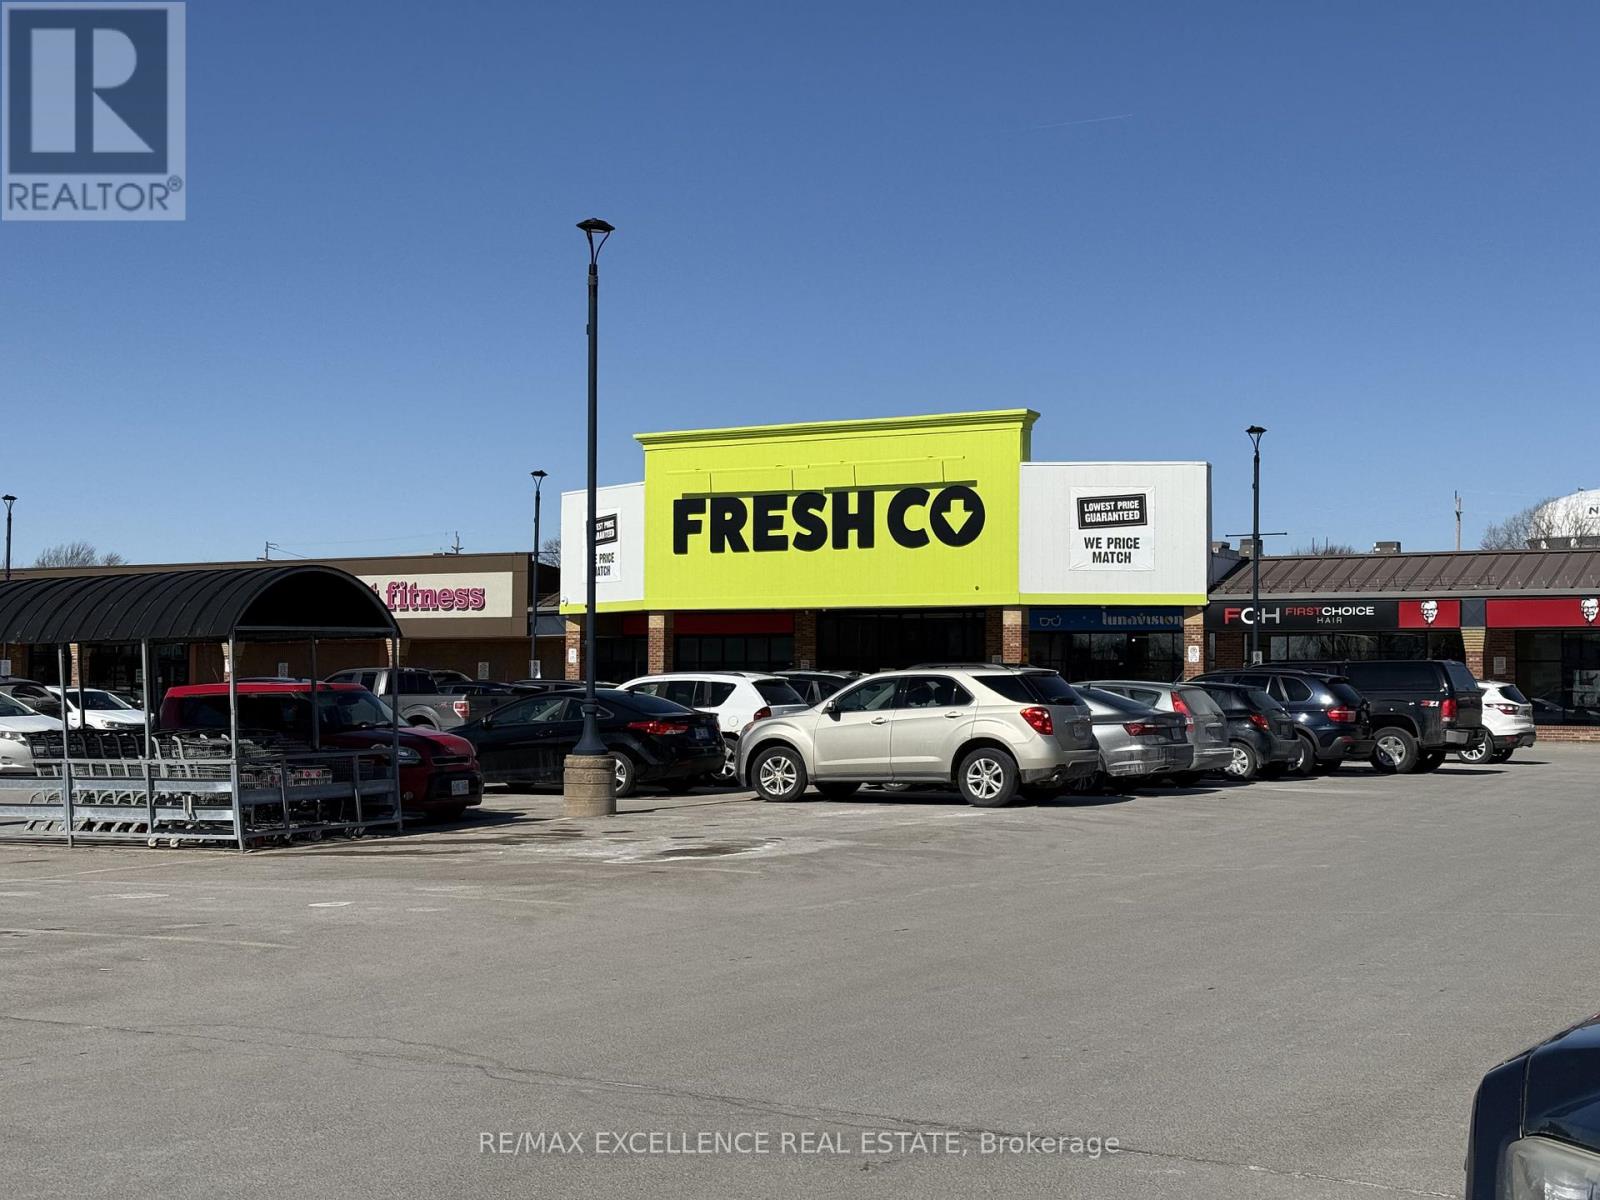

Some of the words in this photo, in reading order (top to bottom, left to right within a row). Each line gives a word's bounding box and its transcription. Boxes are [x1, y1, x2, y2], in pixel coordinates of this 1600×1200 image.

[1084, 502, 1115, 512] LOWEST
[1117, 500, 1140, 510] PRICE
[673, 490, 875, 555] FRESH
[1084, 511, 1140, 523] GUARANTEED
[1084, 537, 1102, 549] WE
[1107, 537, 1140, 549] PRICE
[599, 552, 615, 564] PRICE
[1092, 551, 1132, 564] MATCH
[386, 581, 486, 612] fitness
[1316, 616, 1343, 624] HAIR
